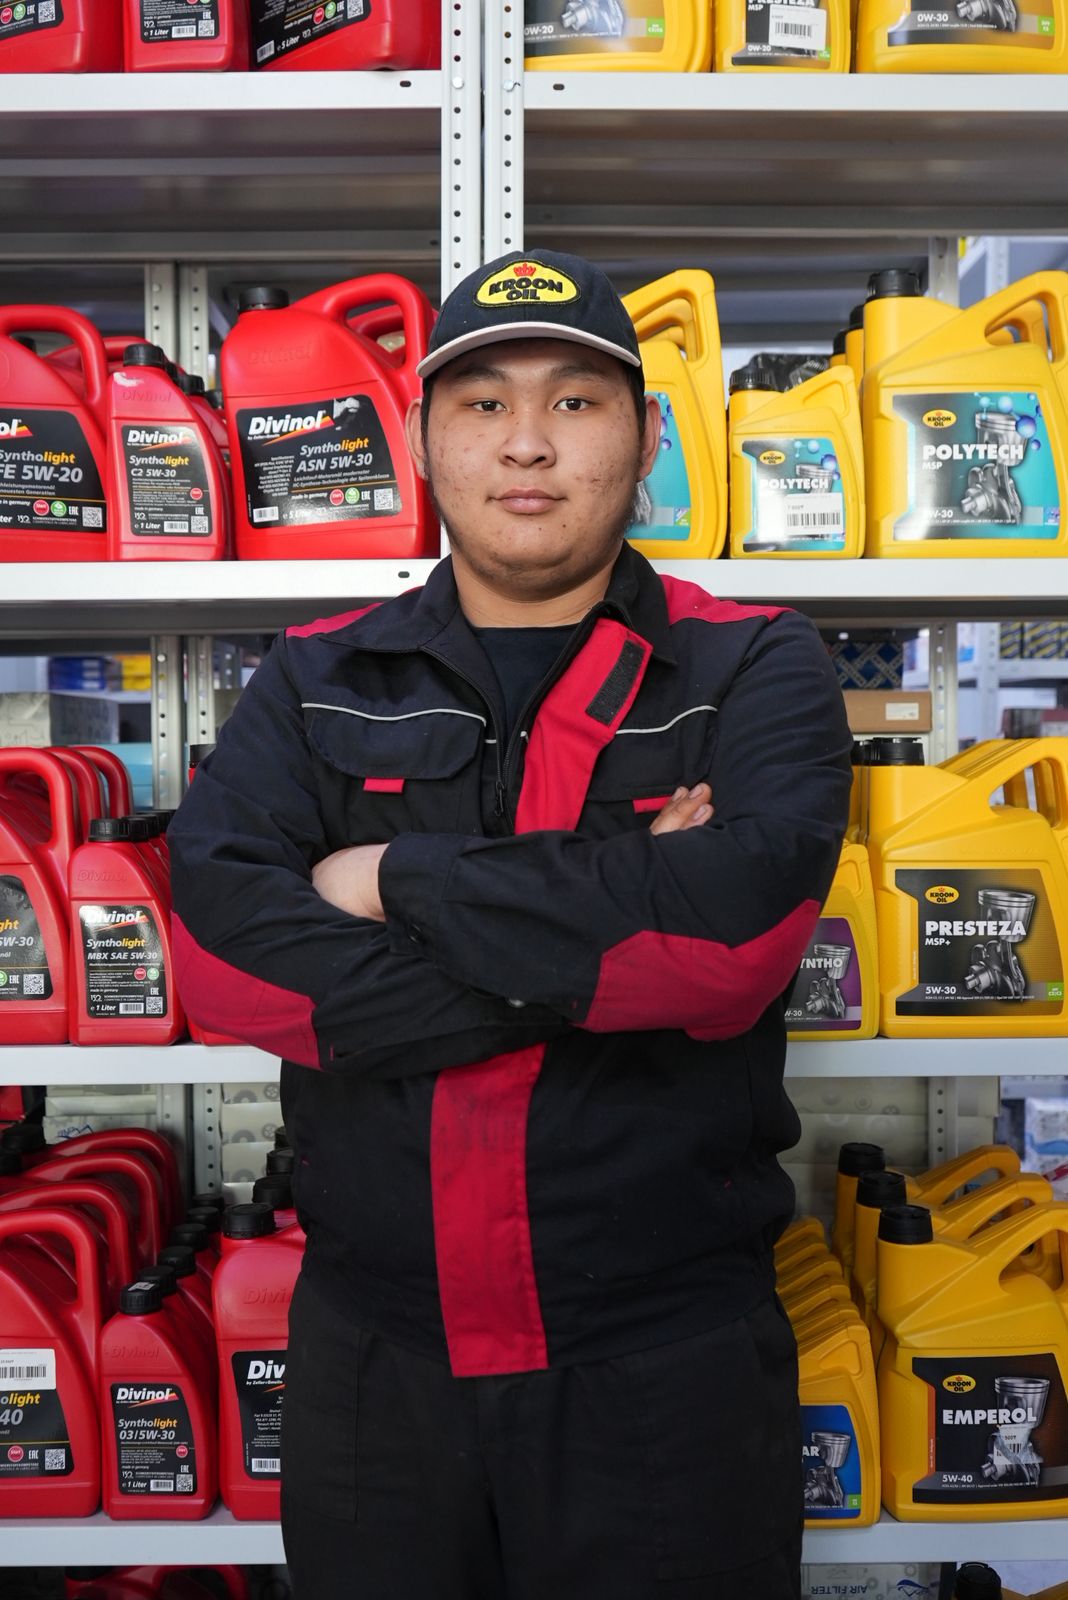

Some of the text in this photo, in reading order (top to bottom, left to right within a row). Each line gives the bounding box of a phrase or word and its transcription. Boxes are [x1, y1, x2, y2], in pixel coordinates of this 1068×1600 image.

[917, 13, 948, 22] 0W-30
[286, 35, 300, 47] Liter
[489, 278, 563, 296] KROON
[506, 289, 540, 300] OIL
[249, 410, 323, 434] Divinol
[128, 430, 182, 444] Divinol
[300, 438, 369, 457] Syntholight
[922, 444, 1023, 460] POLYTECH
[129, 455, 189, 467] Syntholight
[296, 453, 373, 473] ASN 5W-30
[922, 462, 943, 470] MSP
[22, 466, 83, 483] 5W-20
[131, 468, 176, 477] C2 5W-30
[760, 479, 828, 490] POLYTECH
[925, 921, 1026, 936] PRESTEZA
[87, 939, 146, 948] Syntholight
[800, 958, 843, 968] YNTHO
[117, 1388, 170, 1400] Divinol
[942, 1408, 1037, 1425] EMPEROL
[118, 1418, 177, 1429] Syntholight
[802, 1446, 820, 1456] AR
[942, 1474, 973, 1482] 5W-40
[811, 1585, 868, 1594] AIR FILTER
